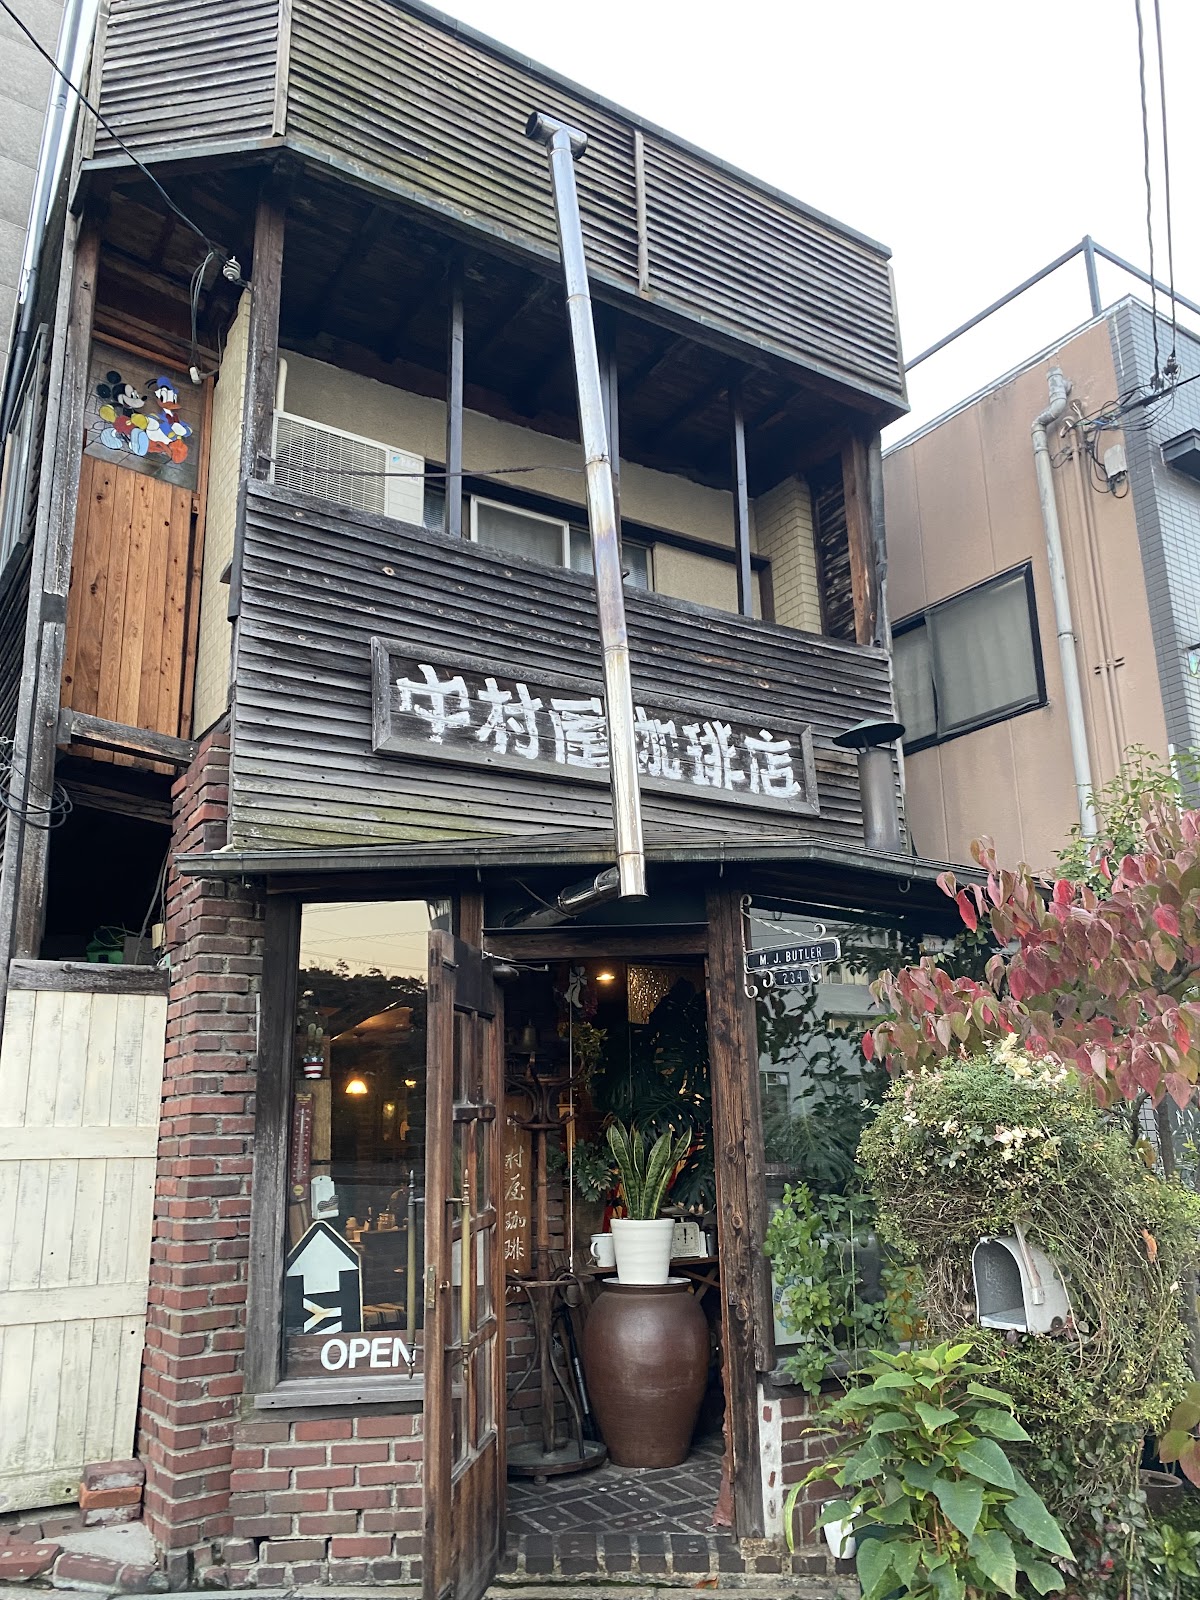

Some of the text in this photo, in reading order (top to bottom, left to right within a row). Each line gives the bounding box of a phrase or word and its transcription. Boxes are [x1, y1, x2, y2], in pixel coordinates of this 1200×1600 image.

[759, 946, 822, 966] M. J. BUTLER
[782, 971, 803, 985] 234
[320, 1336, 416, 1371] OPEN
